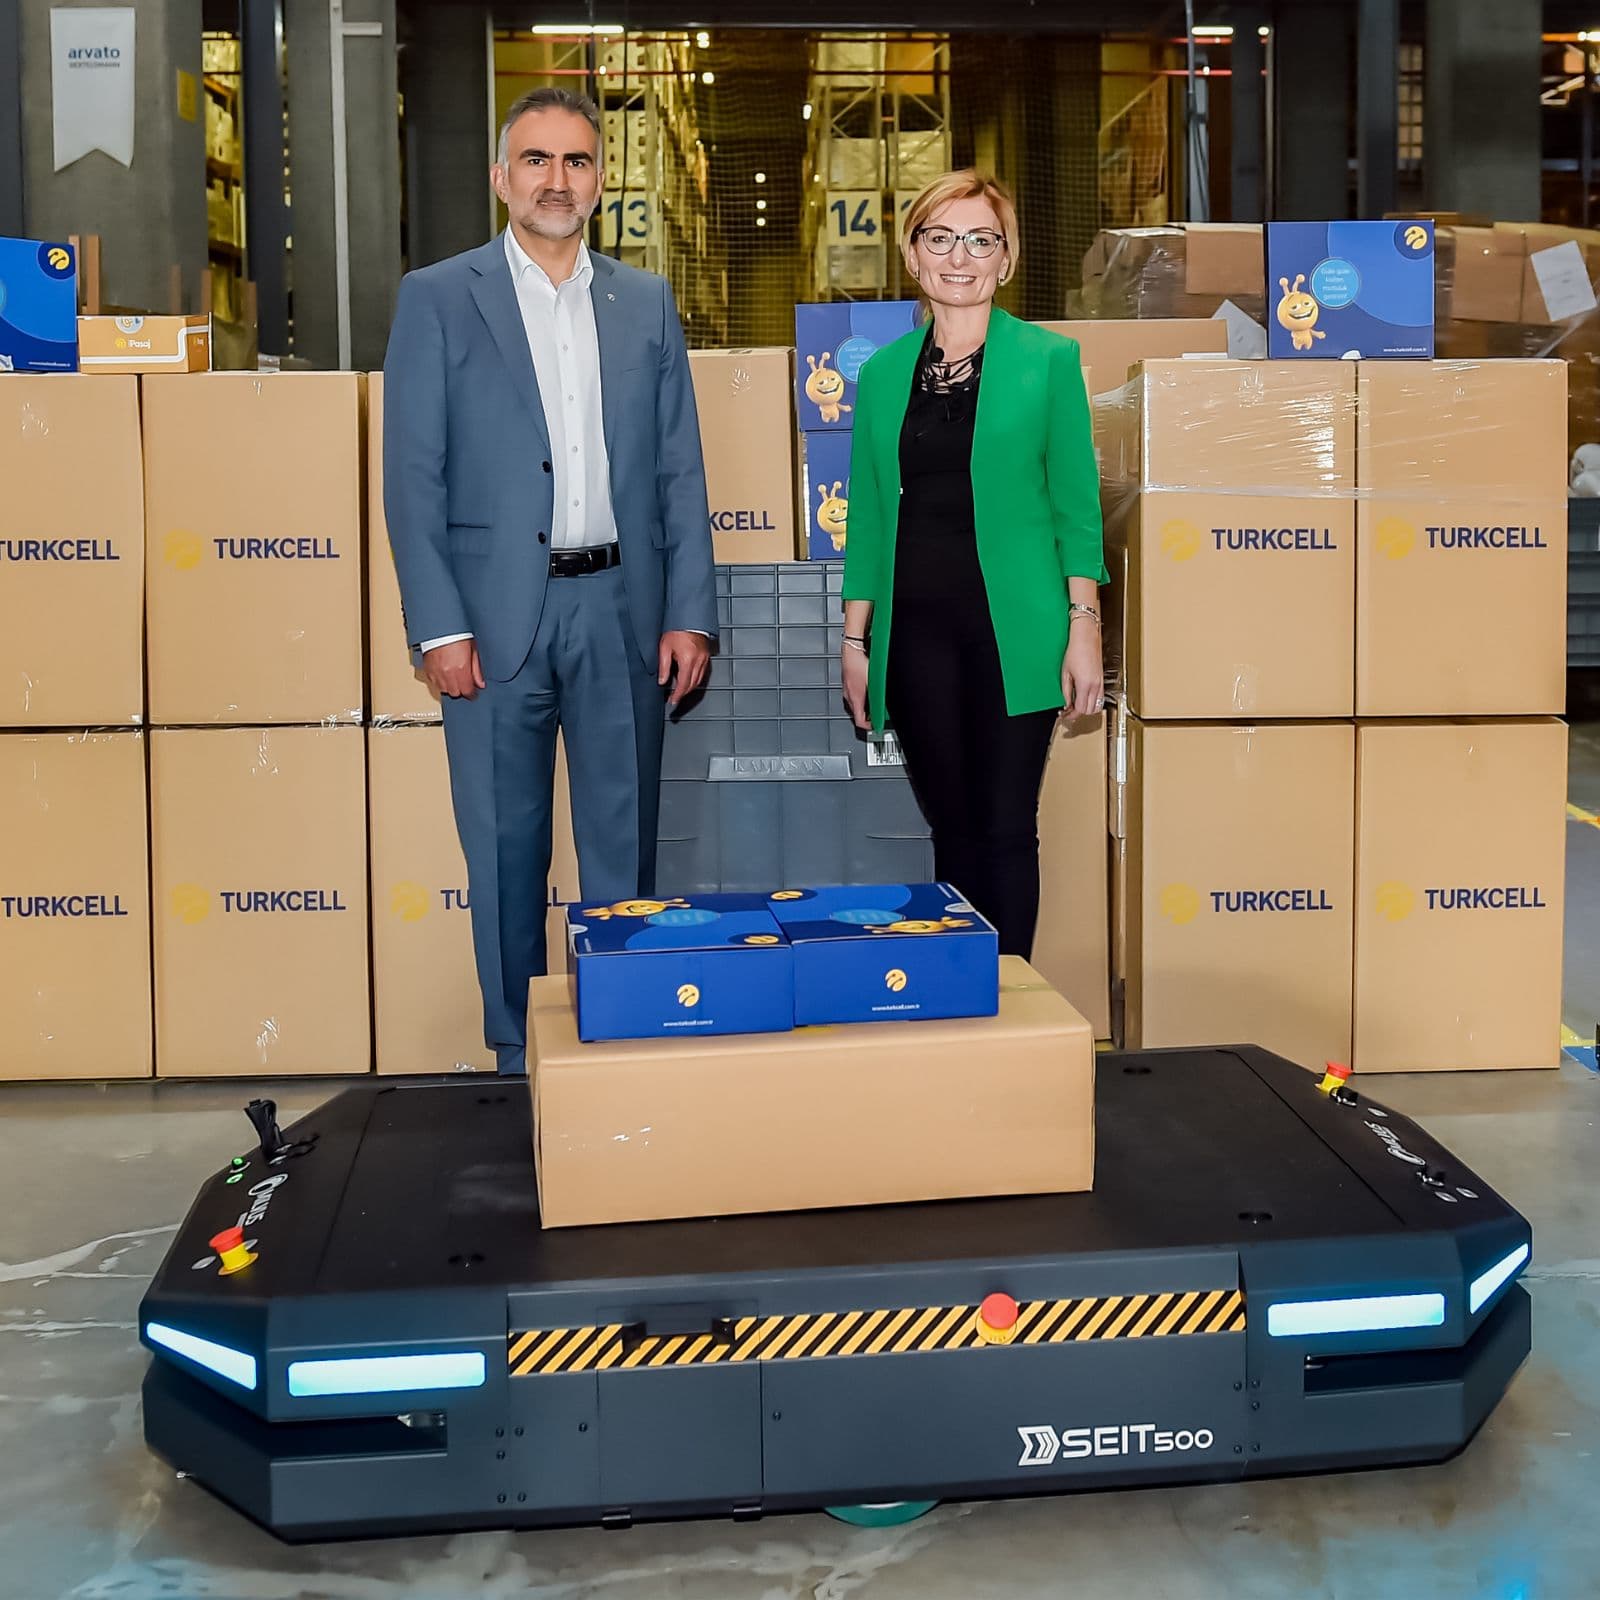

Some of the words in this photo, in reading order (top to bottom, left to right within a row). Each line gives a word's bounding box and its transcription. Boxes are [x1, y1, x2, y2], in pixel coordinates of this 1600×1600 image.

[68, 46, 120, 59] arvato
[607, 200, 653, 238] 13
[831, 199, 877, 237] 14
[708, 510, 776, 531] KCELL
[214, 537, 340, 559] TURKCELL
[1212, 528, 1337, 550] TURKCELL
[1426, 526, 1547, 548] TURKCELL
[1, 895, 128, 918] TURKCELL
[220, 890, 347, 913] TURKCELL
[1210, 889, 1333, 913] TURKCELL
[1425, 887, 1546, 910] TURKCELL
